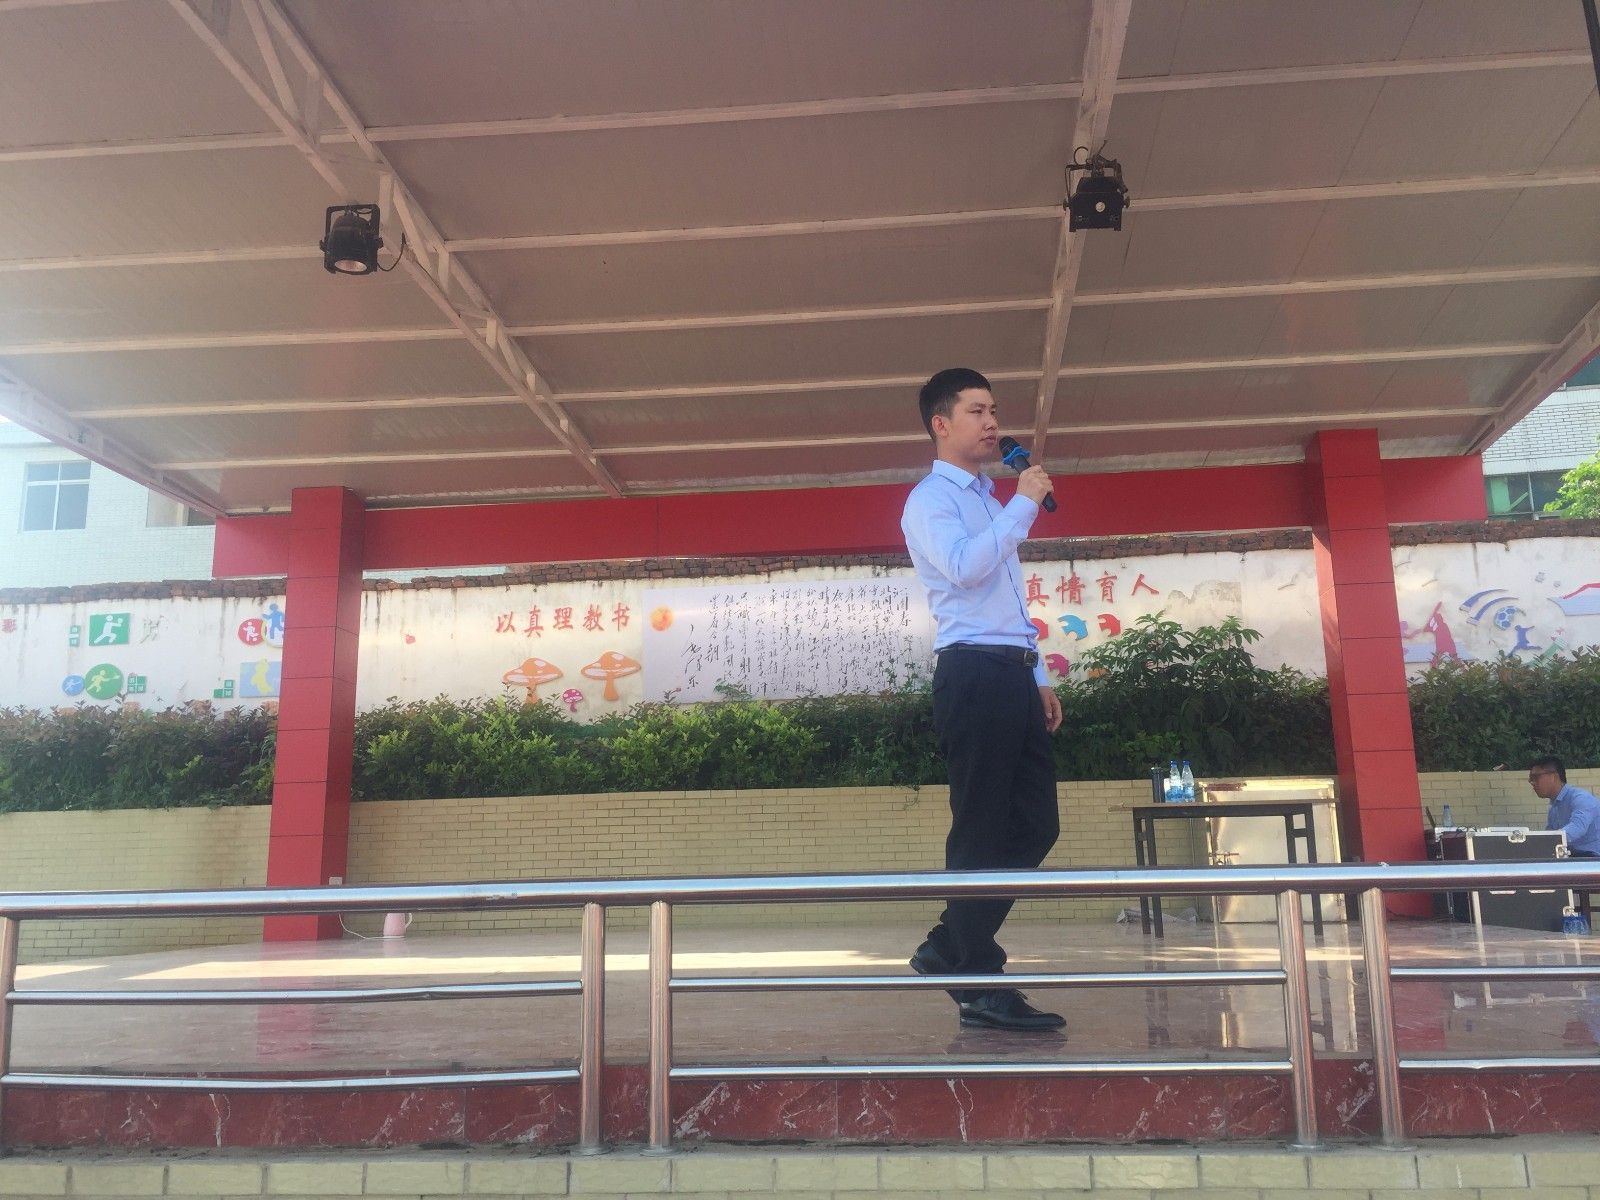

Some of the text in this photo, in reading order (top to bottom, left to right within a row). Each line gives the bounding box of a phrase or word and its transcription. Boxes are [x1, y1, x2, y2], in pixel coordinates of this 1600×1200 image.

[1026, 570, 1160, 607] 真情育人
[495, 602, 630, 638] 以真理教书
